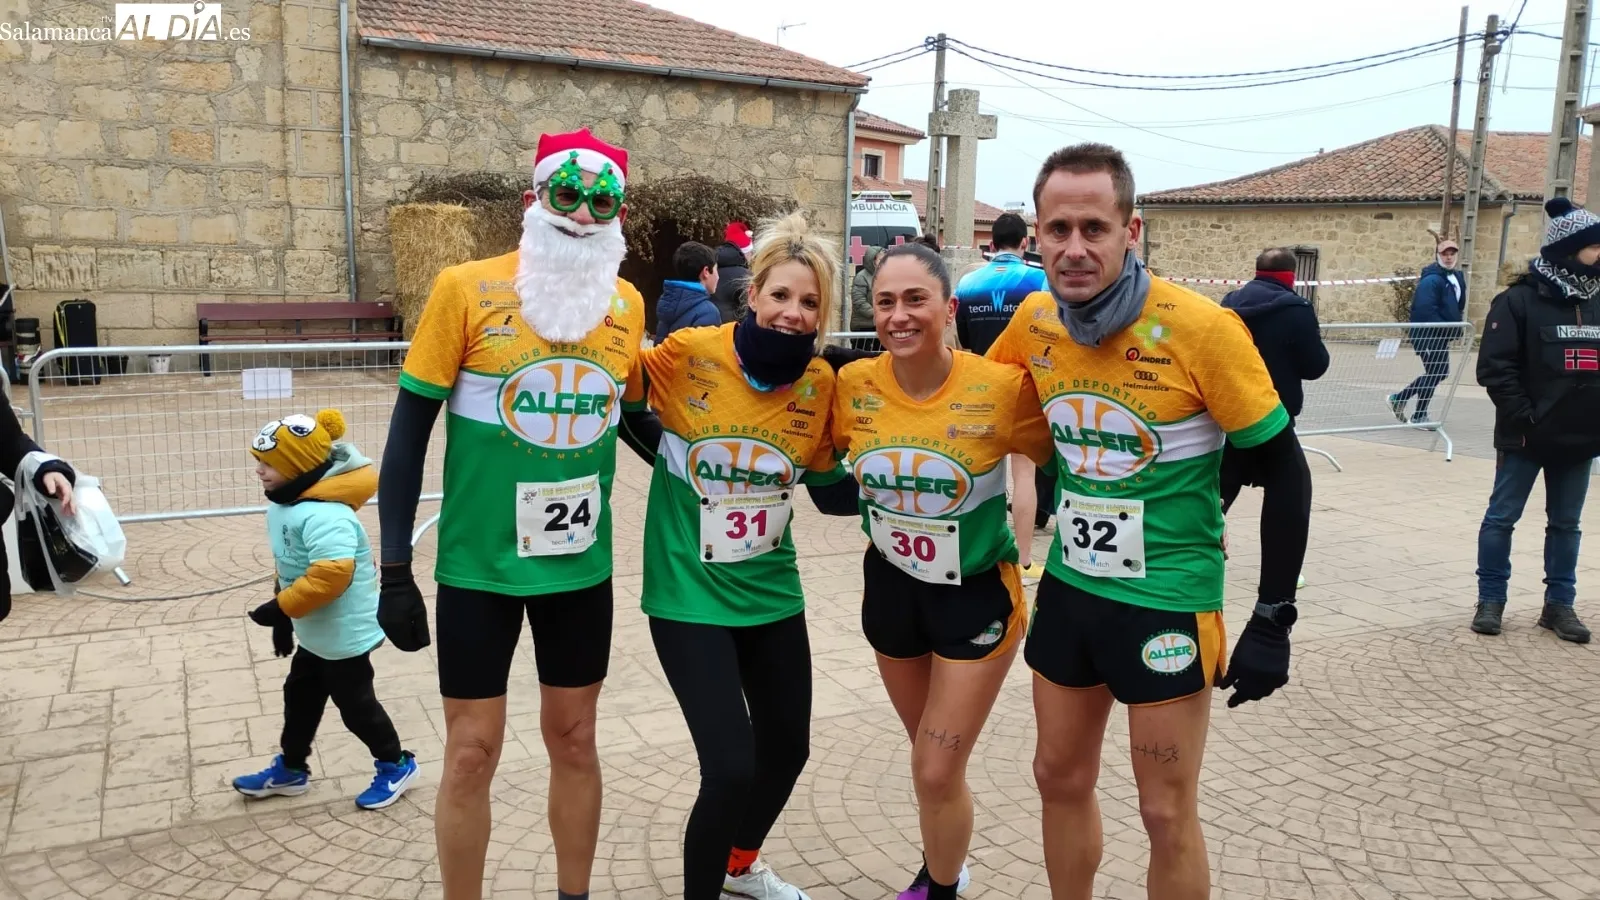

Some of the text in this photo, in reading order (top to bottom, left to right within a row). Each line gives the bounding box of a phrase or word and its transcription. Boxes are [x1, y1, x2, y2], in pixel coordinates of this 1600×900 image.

[851, 203, 908, 212] MBULANCIA
[1559, 326, 1600, 338] NORWAY
[500, 343, 627, 383] CLUB DEPORTIVO
[1041, 379, 1157, 420] CLUB DEPORTIVO
[1123, 382, 1170, 392] Helmántica
[511, 390, 611, 419] ALCER
[686, 424, 803, 464] CLUB DEPORTIVO
[890, 436, 974, 466] DEPORTIVO
[1050, 422, 1147, 458] ALCER
[695, 460, 786, 488] ALCER
[862, 473, 958, 499] ALCER
[544, 498, 591, 532] 24
[726, 510, 767, 539] 31
[890, 531, 936, 562] 30
[1072, 517, 1117, 553] 32
[1148, 645, 1192, 660] ALCER
